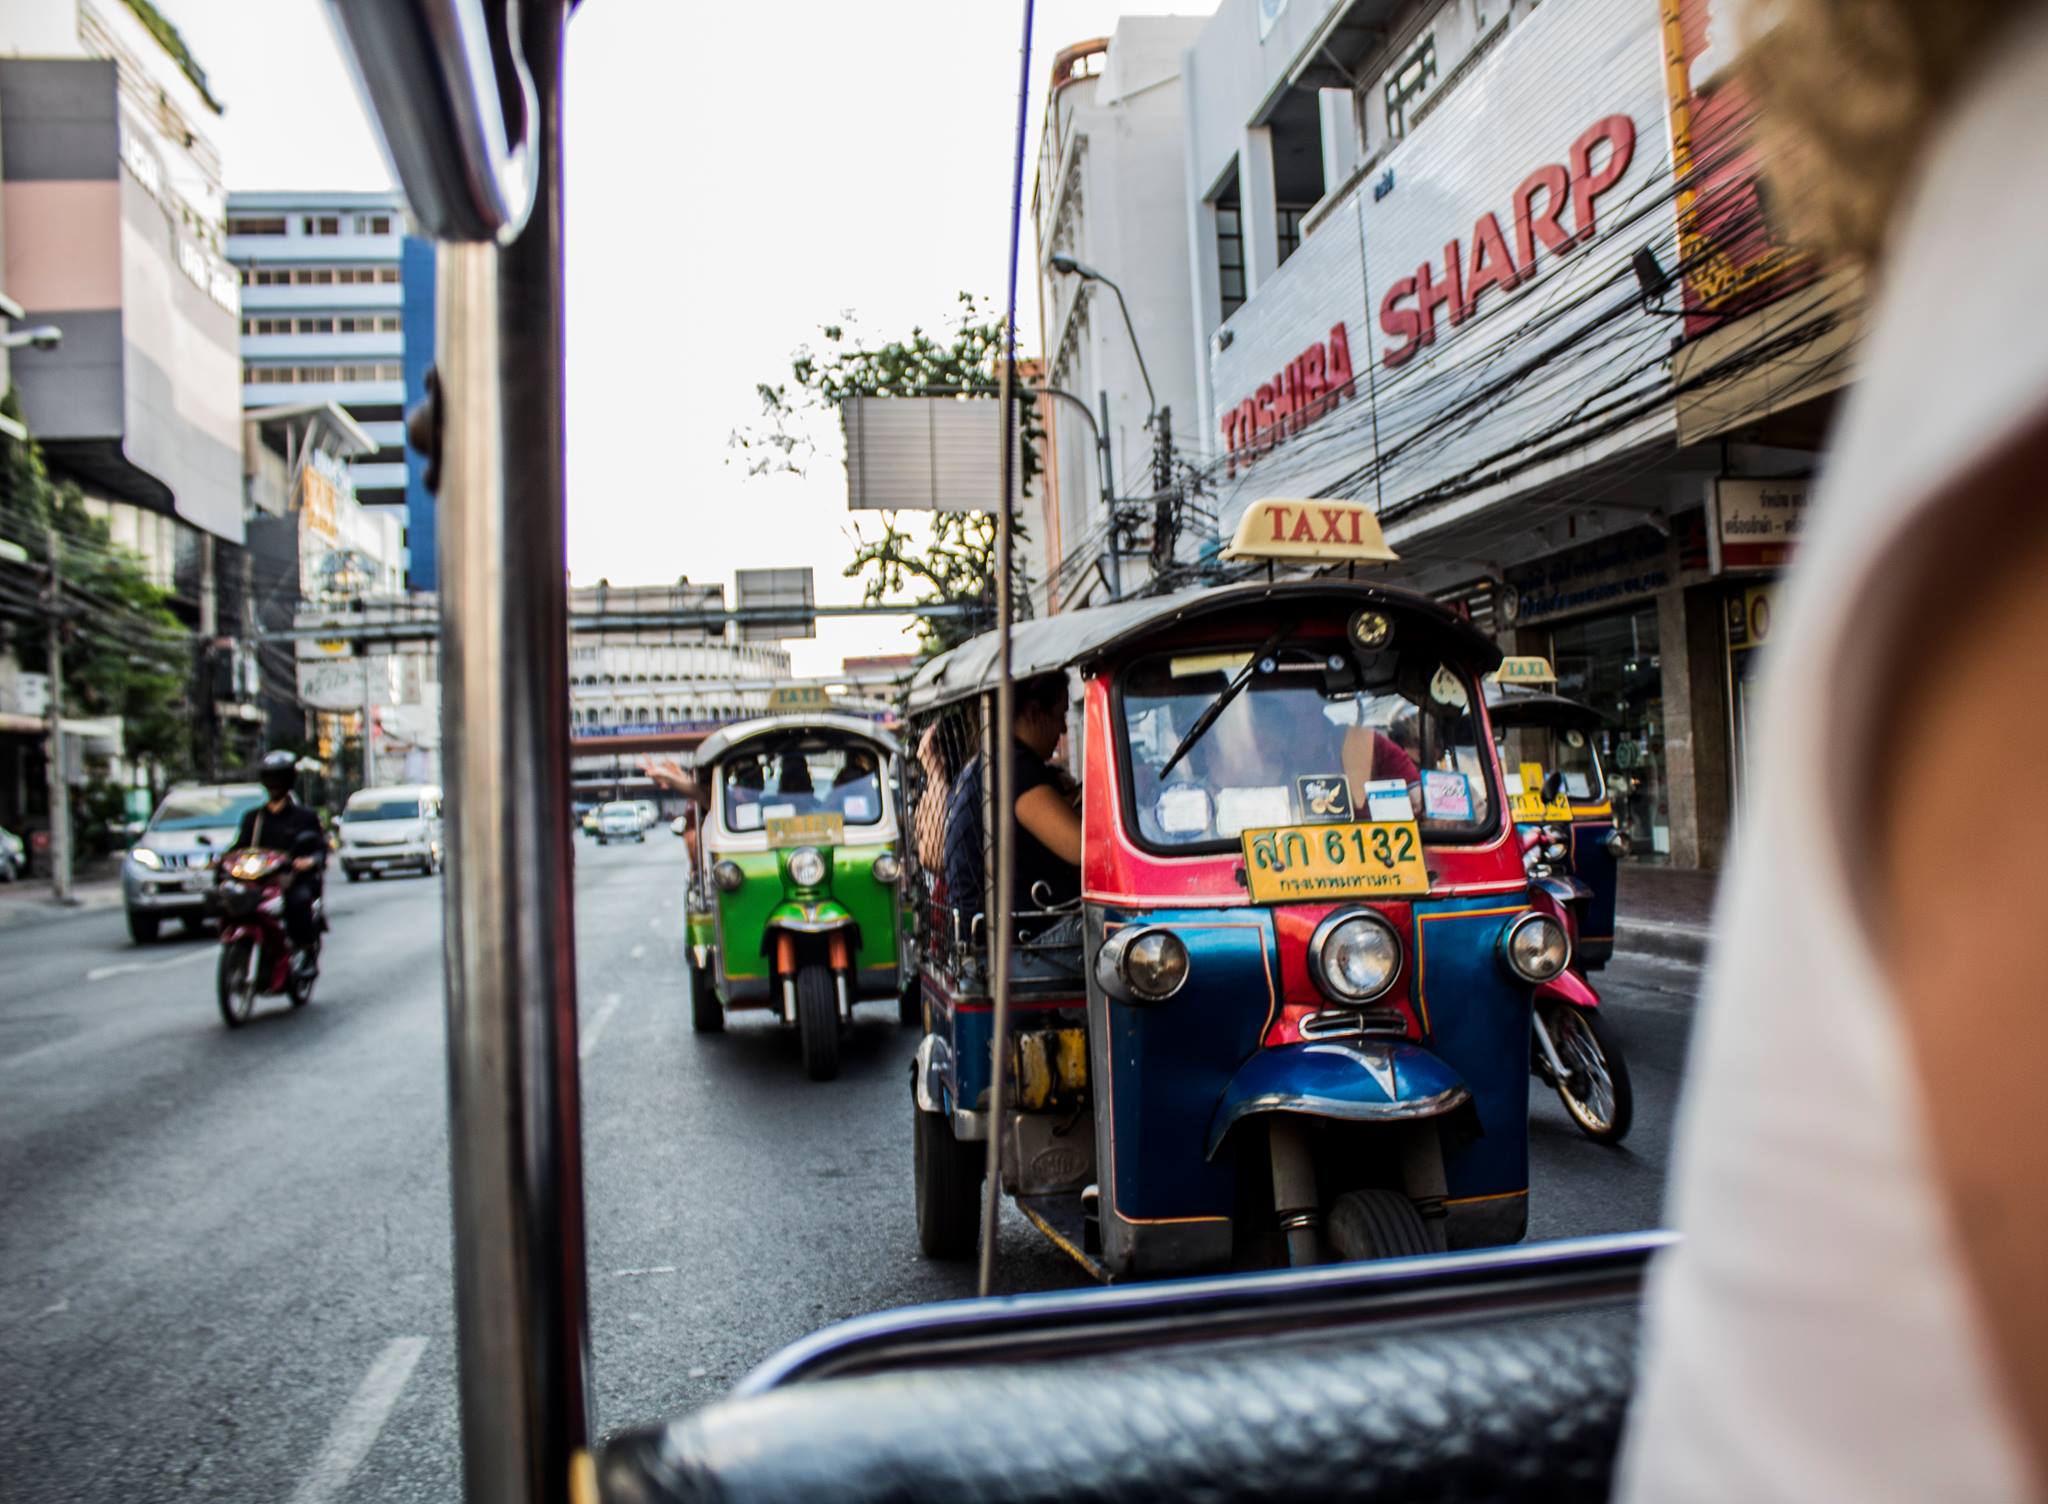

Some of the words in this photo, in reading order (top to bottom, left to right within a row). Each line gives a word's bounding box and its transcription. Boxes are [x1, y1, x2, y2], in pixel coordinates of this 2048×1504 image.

[1221, 321, 1356, 480] TOSHIBA
[1379, 113, 1636, 368] SHARP
[1263, 505, 1364, 545] TAXI
[1507, 661, 1546, 676] TAXI
[777, 689, 822, 705] TAXI
[1324, 827, 1417, 867] 6132
[1279, 873, 1401, 896] กรุงเทพมหานคร
